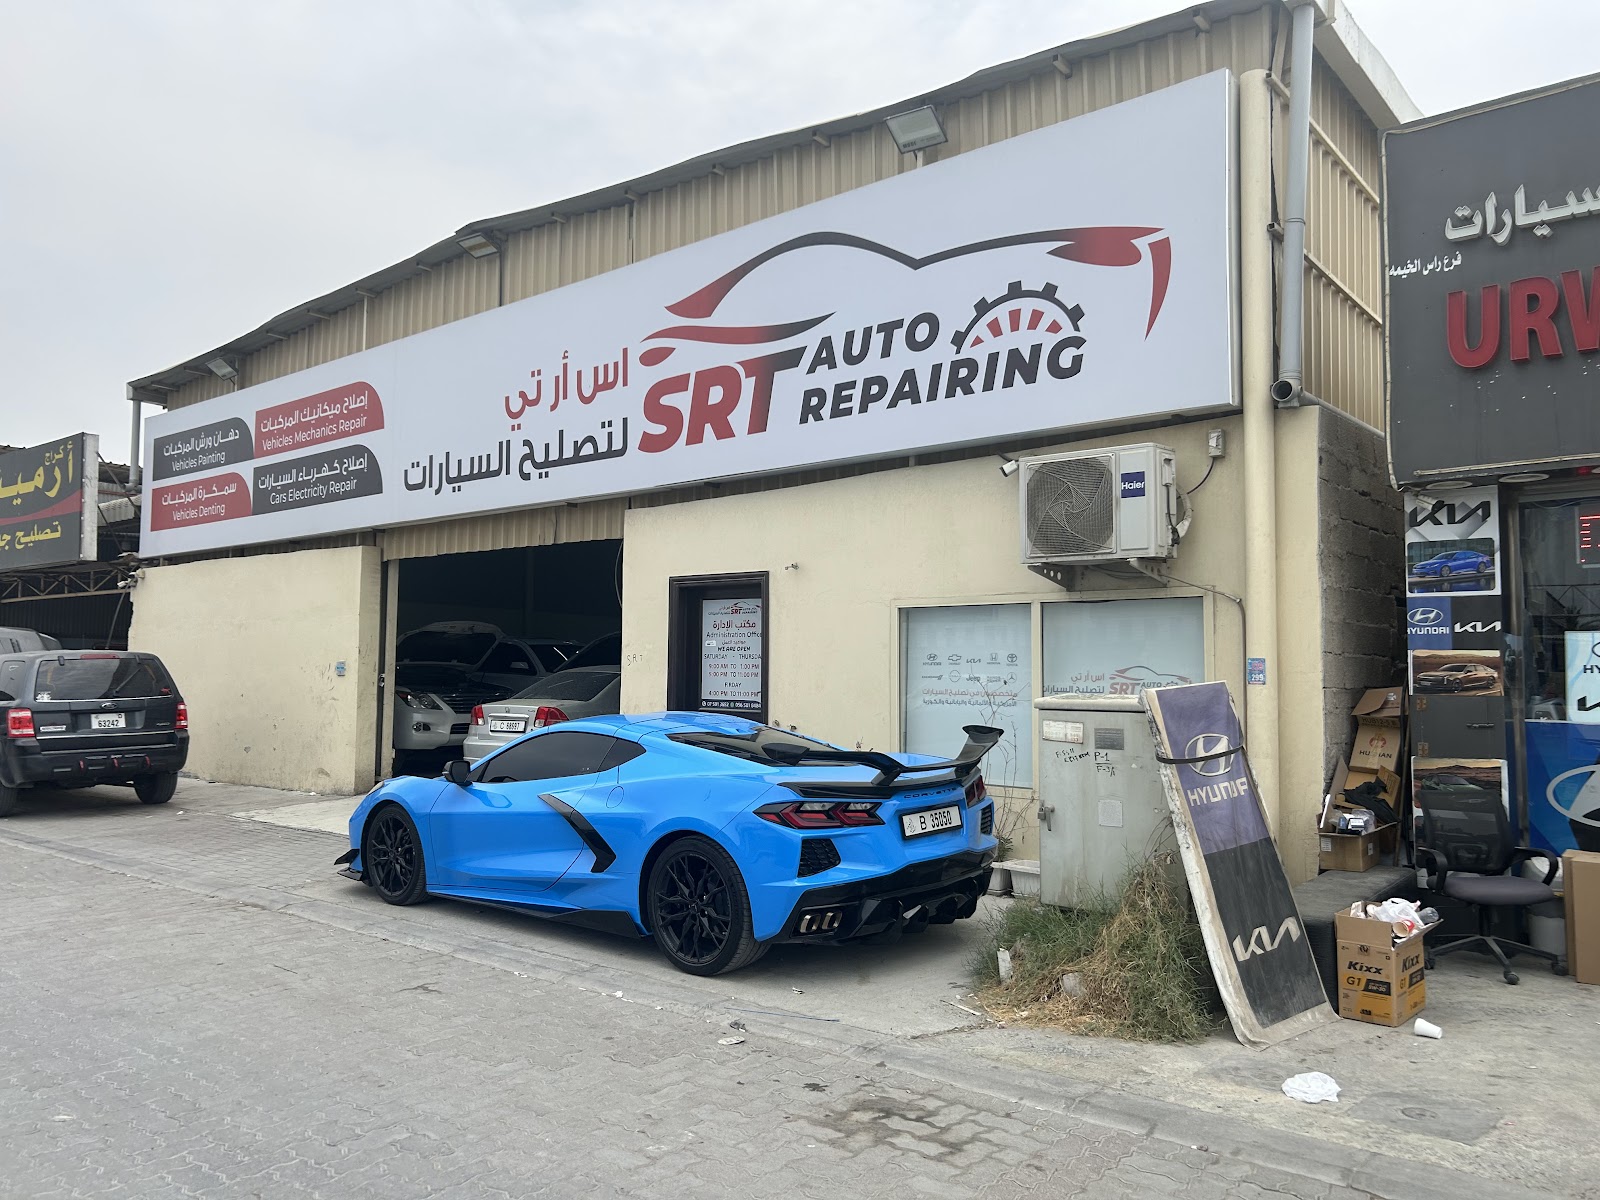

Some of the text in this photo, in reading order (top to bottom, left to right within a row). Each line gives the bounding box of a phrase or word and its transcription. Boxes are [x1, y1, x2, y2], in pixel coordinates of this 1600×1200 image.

[1422, 255, 1442, 275] راس
[1443, 250, 1462, 272] فرع
[805, 311, 940, 375] AUTO
[798, 334, 1087, 425] REPAIRING
[342, 390, 368, 414] إصلاح
[637, 345, 808, 454] SRT
[260, 409, 299, 433] المركبات
[262, 413, 367, 451] Vehicles Mechanics Repair
[163, 437, 195, 457] المركبات
[403, 416, 629, 495] لتصليح السيارات
[172, 451, 226, 472] Vehicles Painting
[258, 452, 368, 490] إصلاح كهرباء السيارات
[269, 476, 358, 505] Cars Electricity Repair
[1121, 480, 1145, 491] Haier
[161, 487, 198, 507] المركبات
[172, 502, 226, 521] Vehicles Denting
[15, 520, 62, 550] تصليح
[1109, 682, 1140, 695] SRT
[903, 787, 958, 799] CORVETTE
[919, 810, 952, 831] B 35050
[1347, 961, 1383, 974] Kixx
[1402, 954, 1420, 973] Kixx
[1346, 976, 1362, 986] G1
